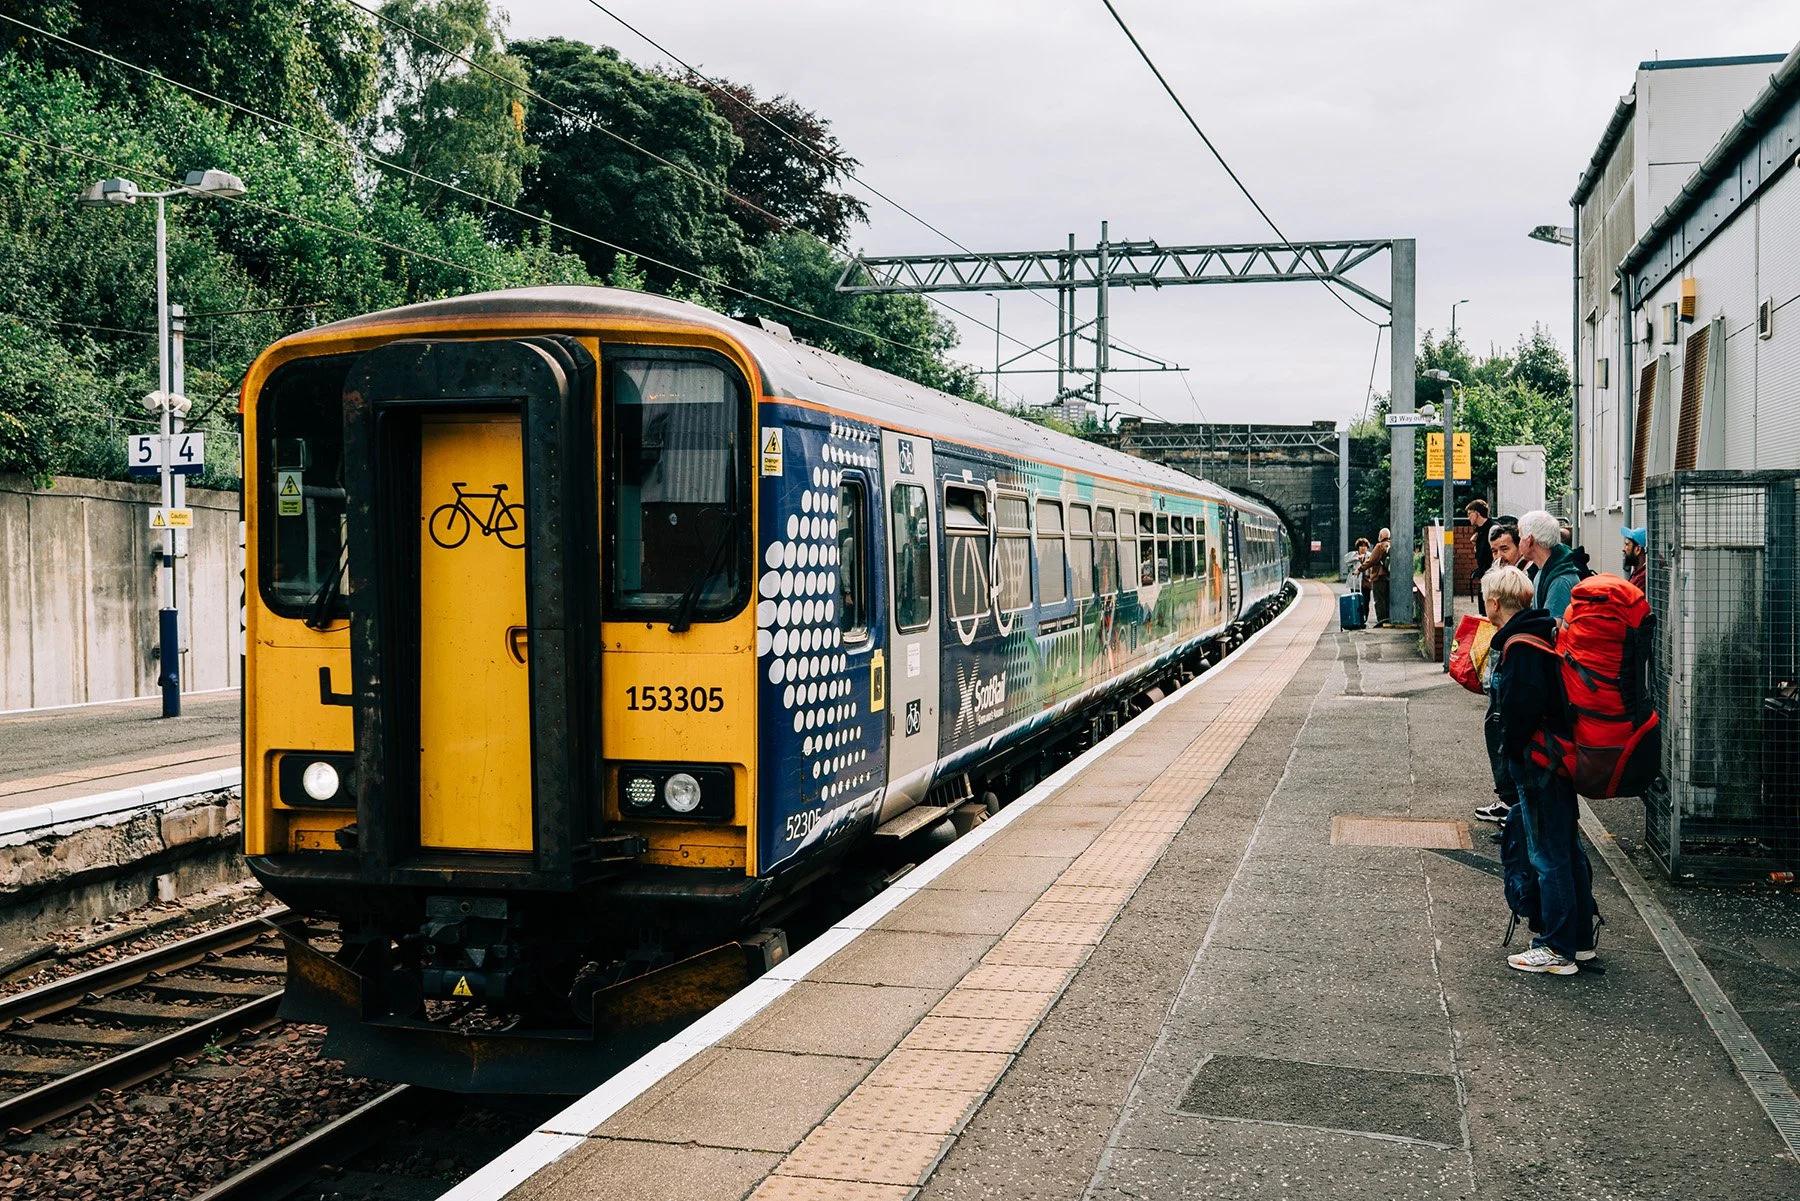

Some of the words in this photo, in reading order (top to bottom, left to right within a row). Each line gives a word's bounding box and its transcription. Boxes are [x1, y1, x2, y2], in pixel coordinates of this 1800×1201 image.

[138, 437, 152, 463] 5
[179, 436, 194, 462] 4
[625, 686, 724, 712] 153305
[974, 671, 1006, 712] ScotRail
[785, 807, 822, 842] 52305
